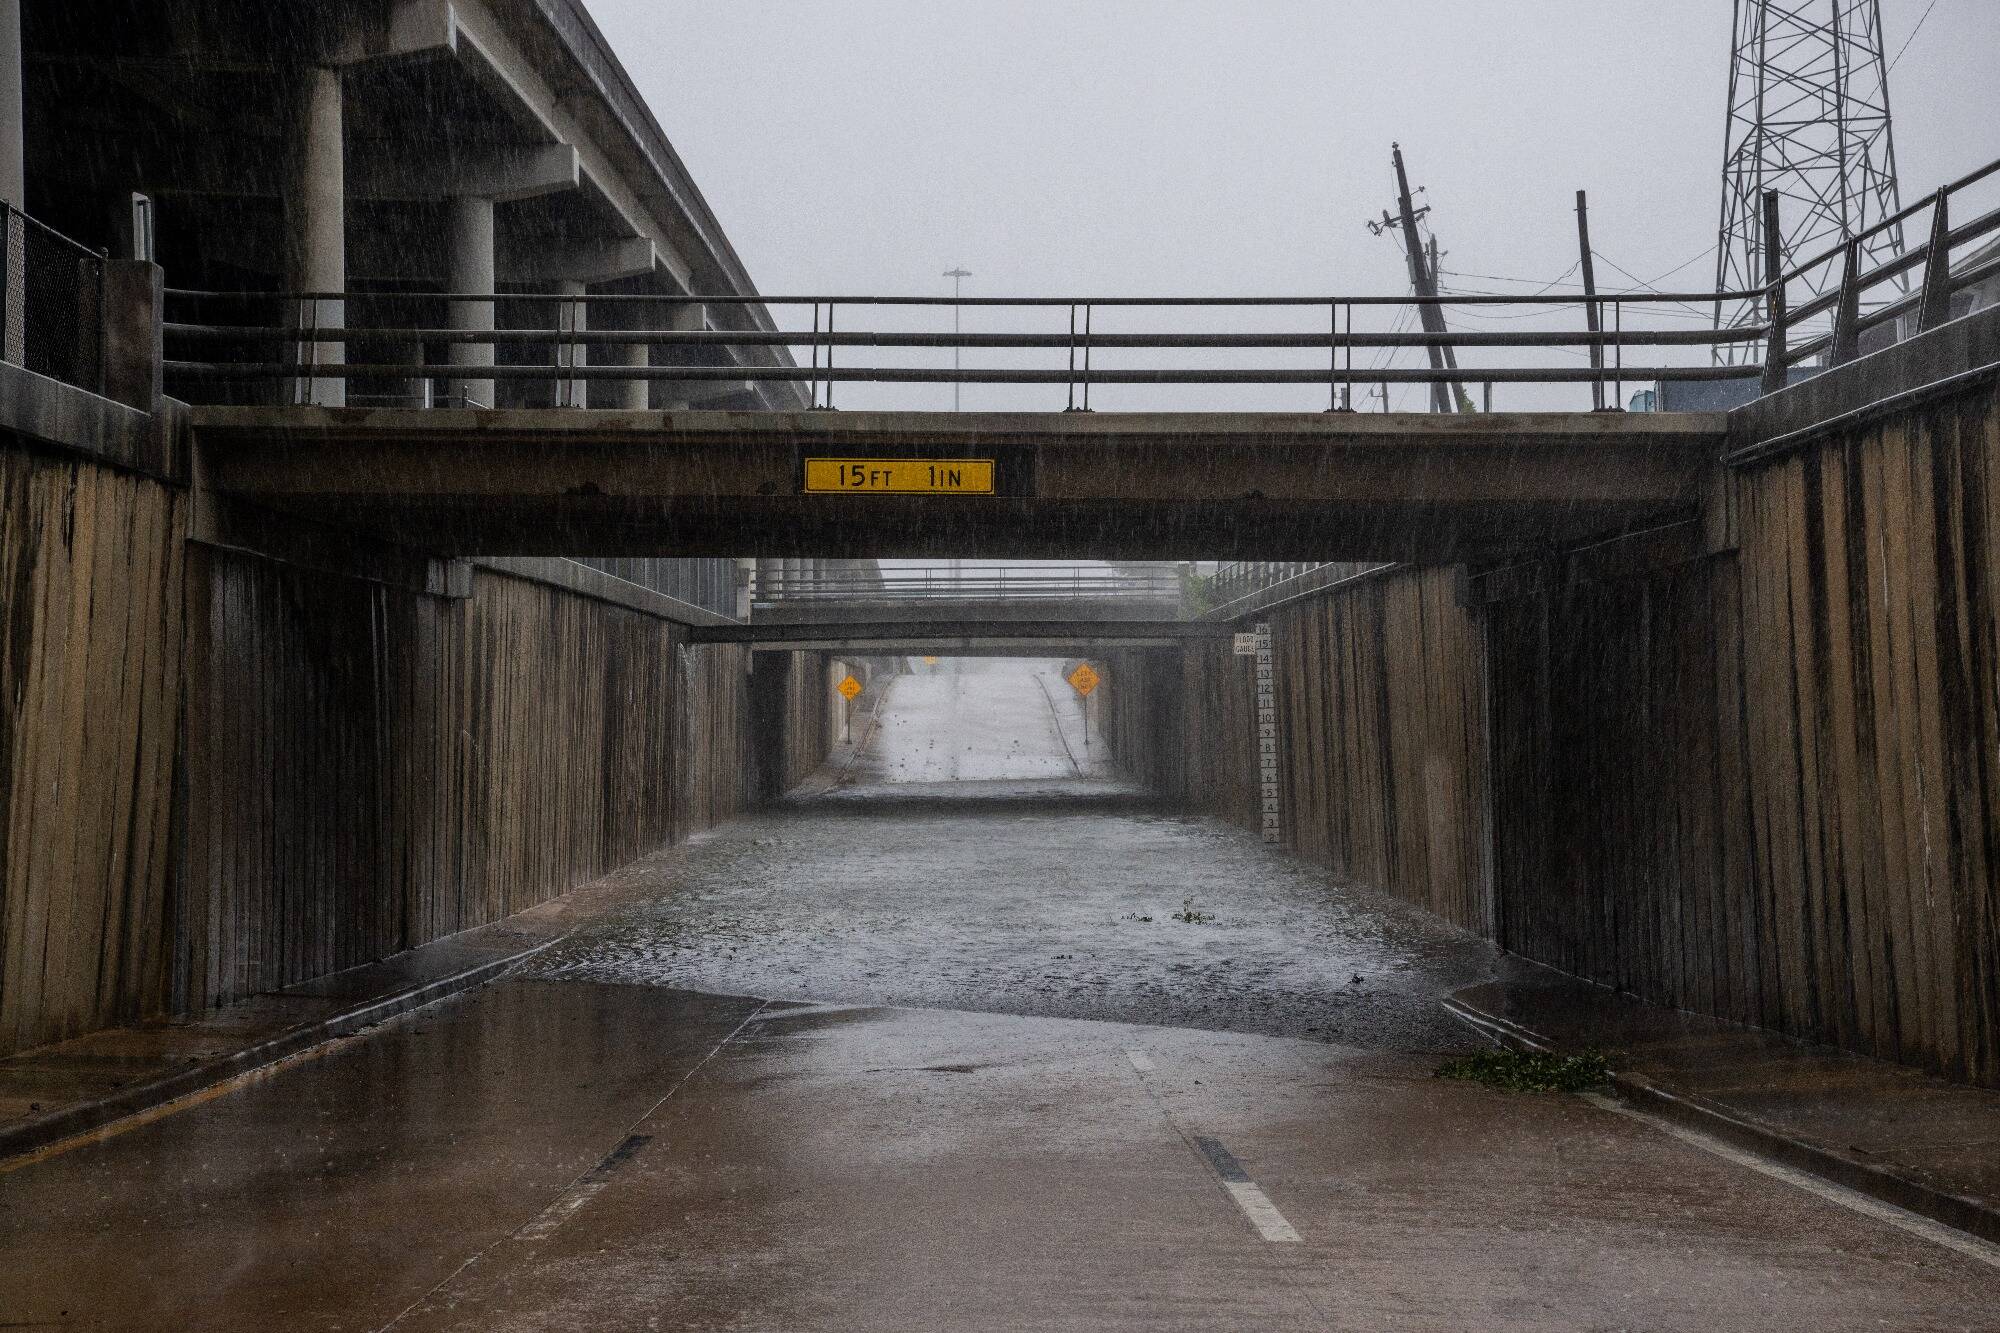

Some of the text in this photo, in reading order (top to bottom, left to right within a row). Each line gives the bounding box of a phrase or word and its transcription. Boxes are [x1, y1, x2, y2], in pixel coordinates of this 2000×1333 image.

[1259, 639, 1269, 648] 15
[1260, 654, 1270, 663] 14
[1260, 669, 1270, 678] 13
[1261, 684, 1271, 692] 12
[1263, 699, 1270, 707] 11
[1262, 713, 1272, 722] 10
[1264, 728, 1271, 736] 9
[1265, 743, 1271, 751] 8
[1265, 758, 1271, 766] 7
[1266, 773, 1272, 781] 6
[1266, 788, 1273, 796] 5
[1267, 803, 1274, 811] 4
[1268, 818, 1274, 827] 3
[1268, 833, 1275, 841] 2
